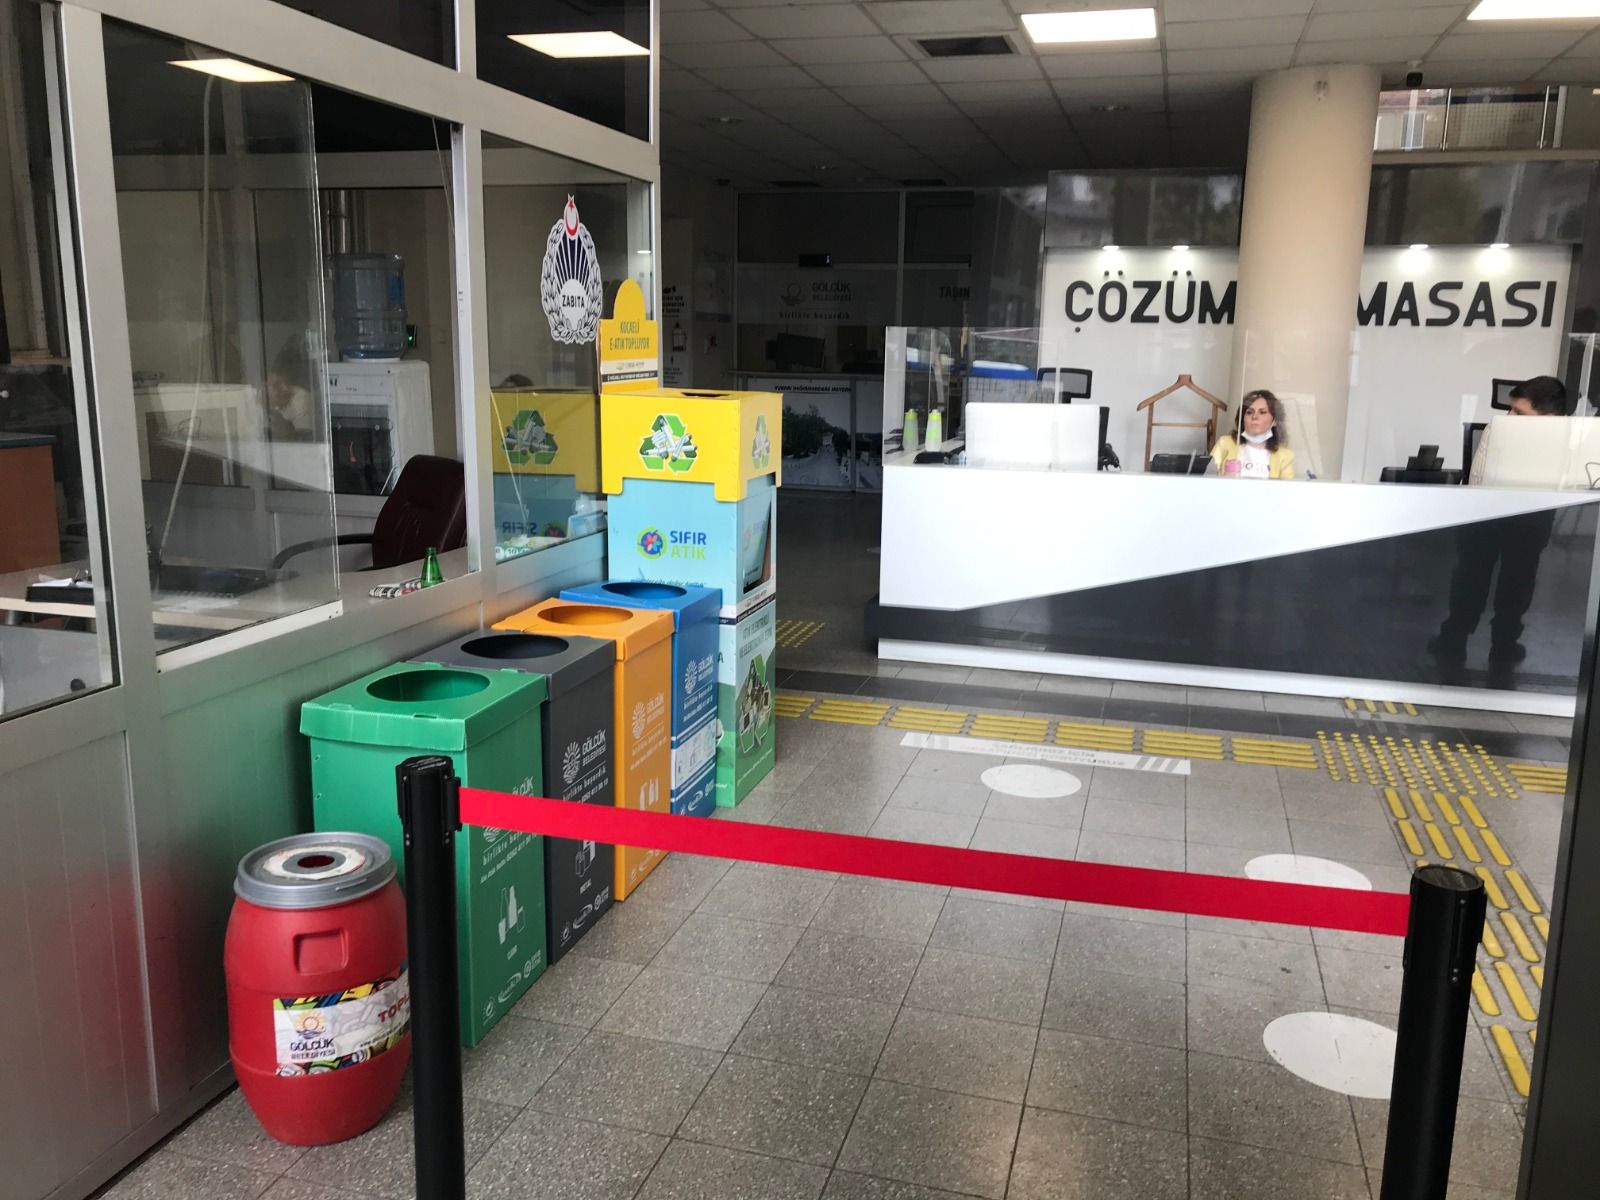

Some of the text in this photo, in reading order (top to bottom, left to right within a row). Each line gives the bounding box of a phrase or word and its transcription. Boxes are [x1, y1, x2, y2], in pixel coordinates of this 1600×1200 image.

[561, 294, 585, 309] ZABITA
[1065, 270, 1557, 333] ÇÖZÜM MASASI
[670, 529, 707, 546] SIFIR
[670, 545, 707, 560] ATIK
[582, 729, 607, 755] GÖLCÜK
[289, 1037, 335, 1052] GÖLCÜK
